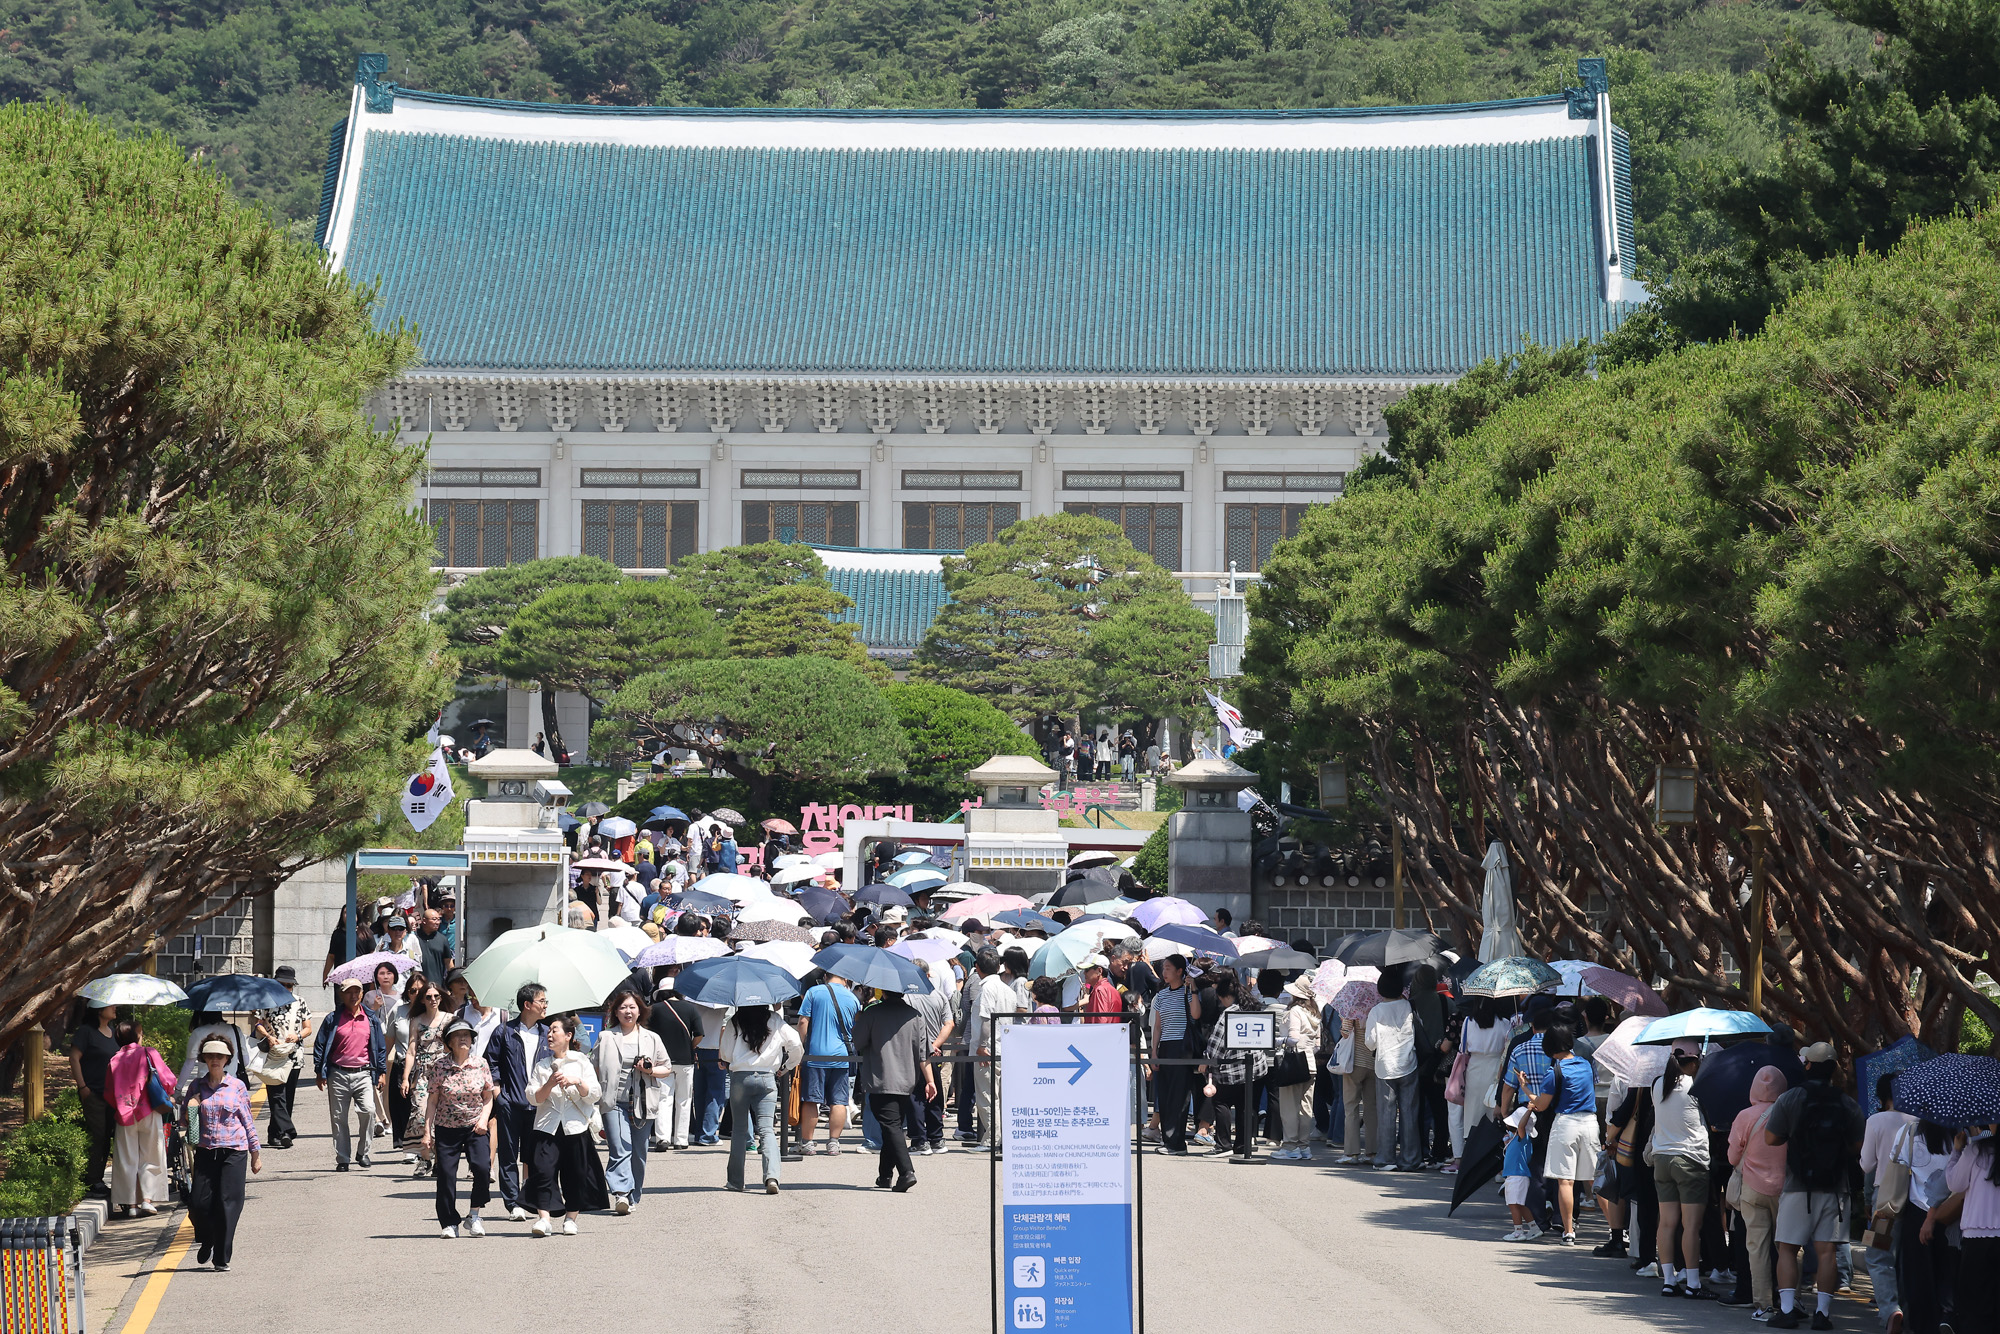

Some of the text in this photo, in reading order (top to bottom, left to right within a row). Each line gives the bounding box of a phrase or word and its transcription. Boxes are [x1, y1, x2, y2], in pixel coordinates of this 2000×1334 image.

[1235, 1022, 1266, 1037] 입구
[1032, 1077, 1056, 1085] 220m
[1011, 1106, 1099, 1117] 단체(11~50인)는 춘추문,
[1011, 1117, 1110, 1128] 개인은 정문 또는 춘추문으로
[1011, 1129, 1059, 1139] 입장해주세요
[1011, 1144, 1032, 1152] Groups
[1109, 1143, 1121, 1151] only
[1012, 1212, 1071, 1223] 단체관람객 혜택
[1053, 1256, 1082, 1264] 빠른 입장
[1054, 1296, 1074, 1305] 화장실
